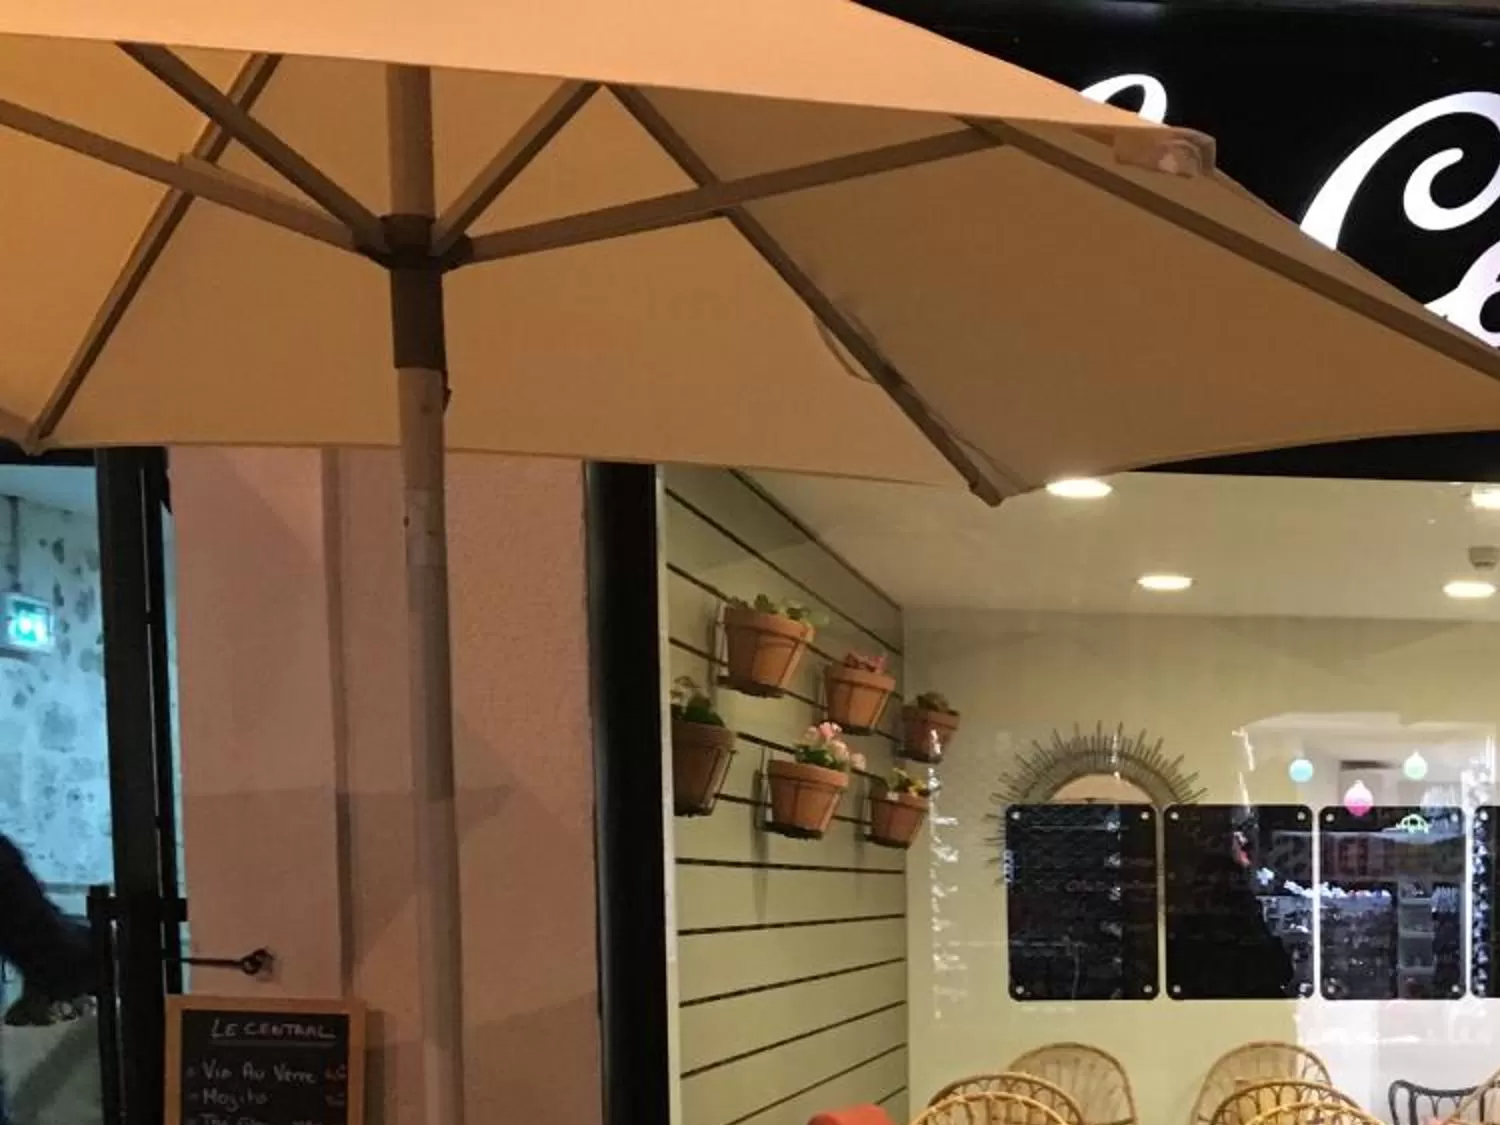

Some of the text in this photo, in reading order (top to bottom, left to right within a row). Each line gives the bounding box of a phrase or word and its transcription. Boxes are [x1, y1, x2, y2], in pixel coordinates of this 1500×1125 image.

[210, 1017, 336, 1039] LE CENTRAL
[273, 1063, 316, 1085] Verre
